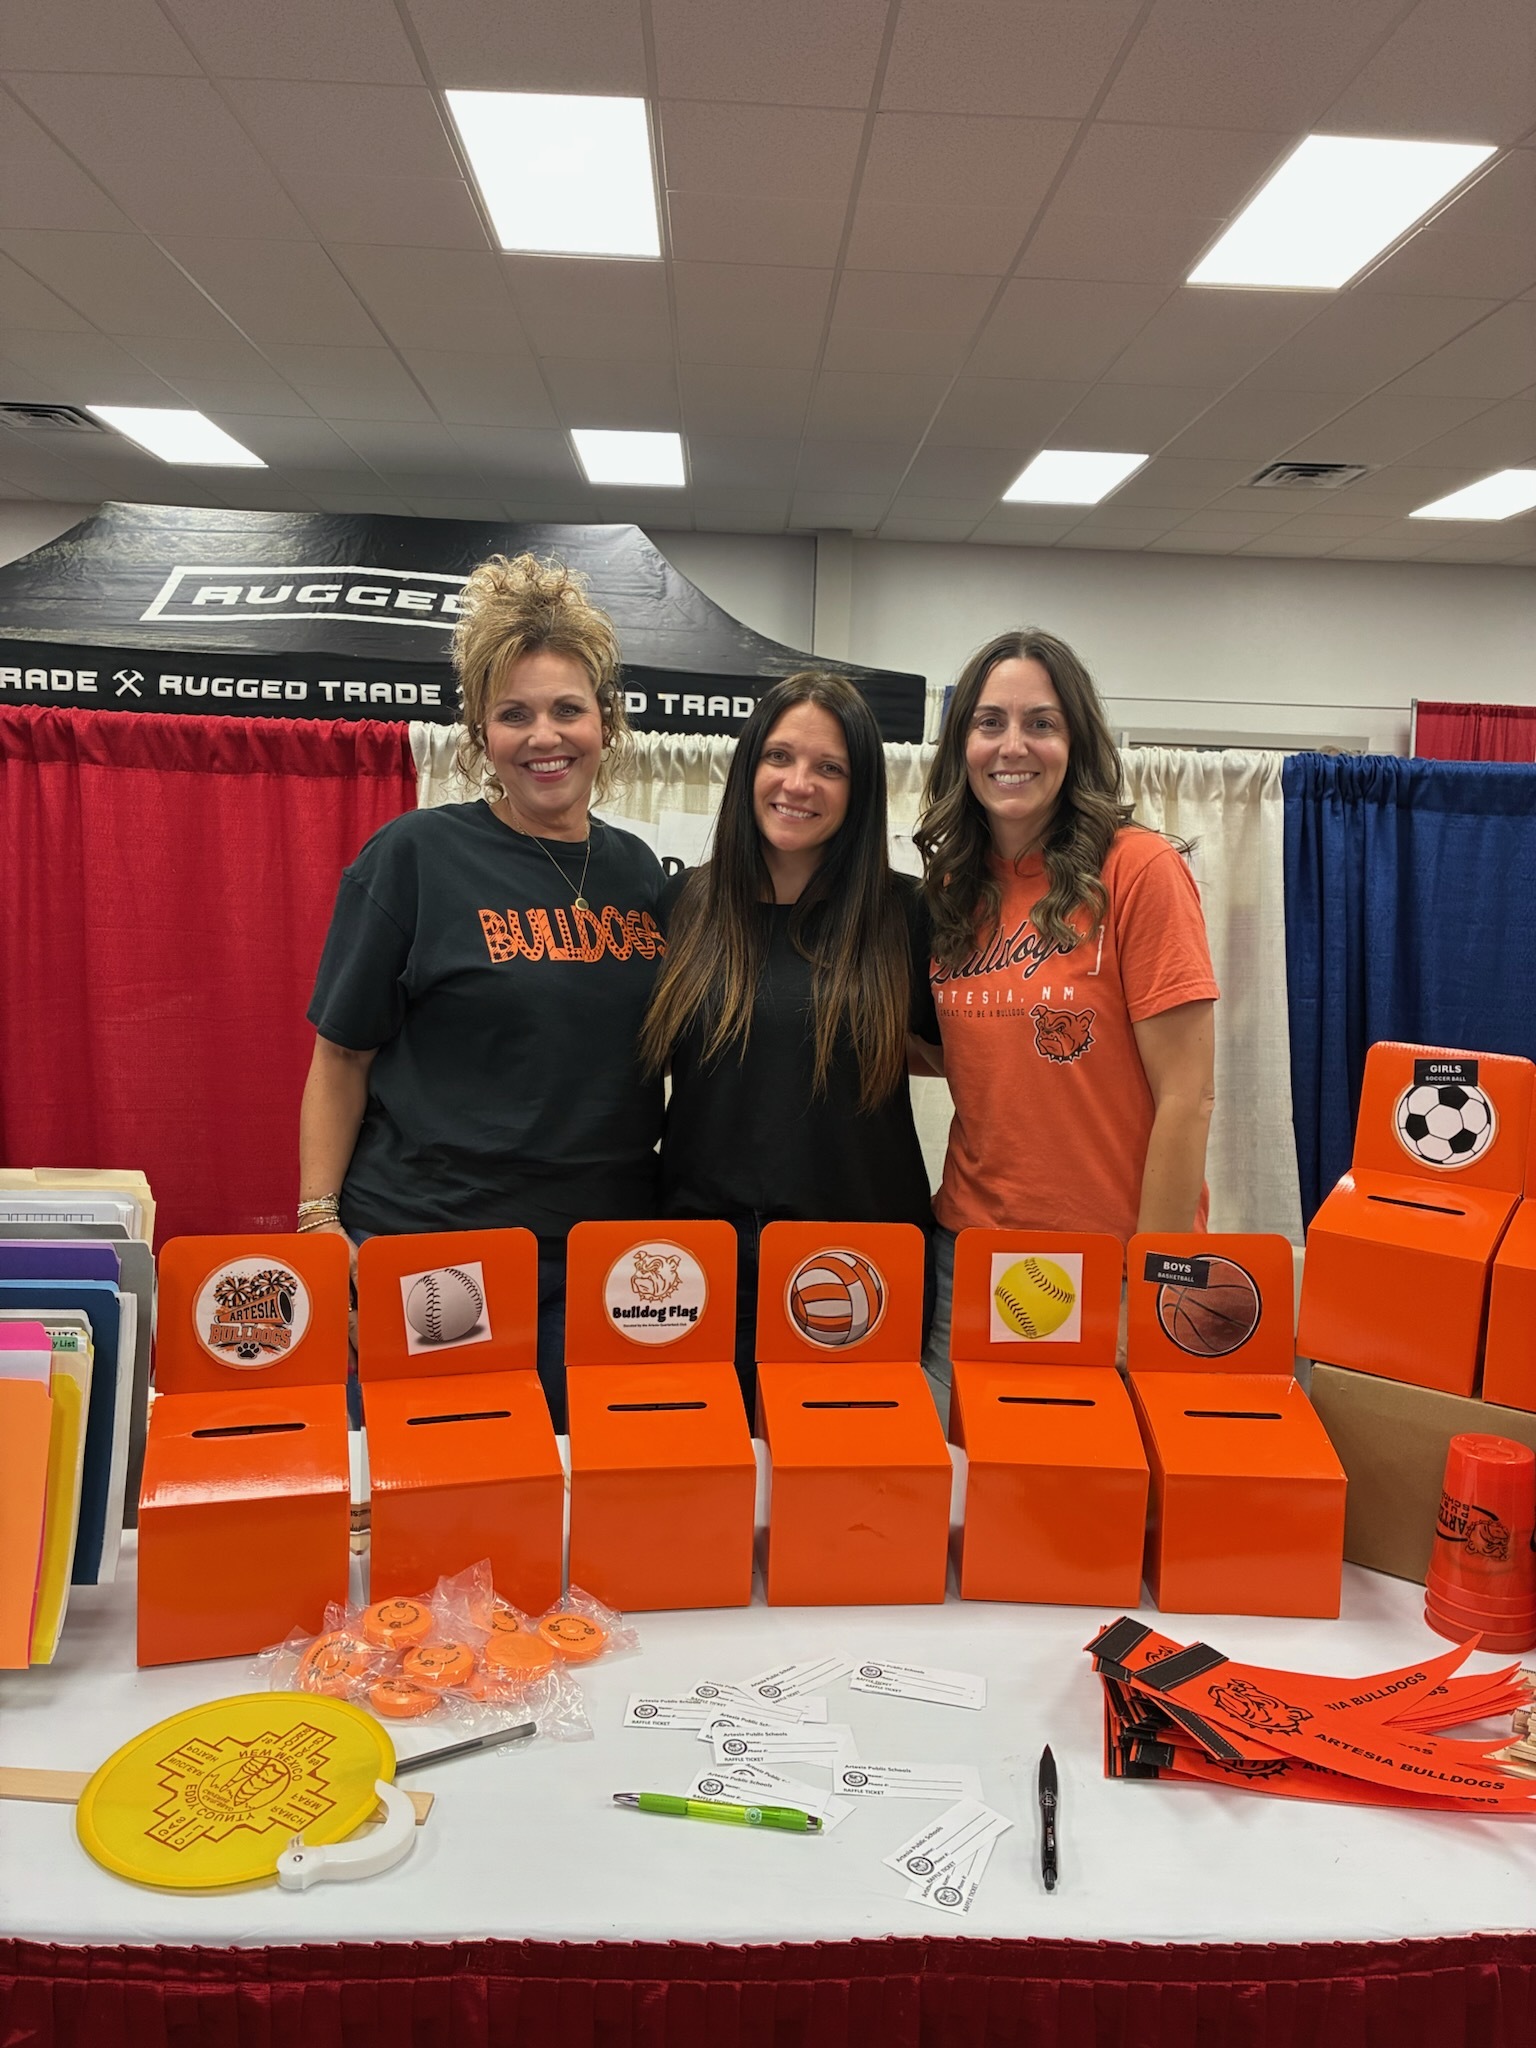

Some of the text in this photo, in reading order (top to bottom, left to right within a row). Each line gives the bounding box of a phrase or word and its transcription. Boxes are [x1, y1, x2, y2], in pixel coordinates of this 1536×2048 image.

[159, 674, 442, 705] RUGGED TRADE
[657, 693, 761, 718] TRAD
[938, 989, 1024, 1004] RTESIA,
[963, 1010, 973, 1018] TO
[977, 1010, 985, 1018] BE
[1429, 1065, 1462, 1073] GIRLS
[1157, 1272, 1194, 1283] BASKETBALL
[1163, 1261, 1192, 1273] BOYS
[229, 1299, 278, 1322] ARTESIA
[613, 1305, 698, 1322] Bulldog Flag
[208, 1324, 292, 1349] BULLDOGS
[751, 1665, 796, 1687] Artesia Public Schools
[1350, 1672, 1428, 1707] BULLDOGS
[720, 1712, 740, 1721] Artesia
[741, 1717, 758, 1725] Public
[1314, 1733, 1394, 1767] ARTESIA
[1400, 1763, 1505, 1790] BULLDOGS
[708, 1772, 728, 1780] Artesia
[748, 1780, 772, 1788] Schools
[896, 1826, 943, 1862] Artesia Public Schools
[926, 1861, 956, 1884] RAFFLE TICKET
[962, 1882, 979, 1912] RAFFLE TICKET
